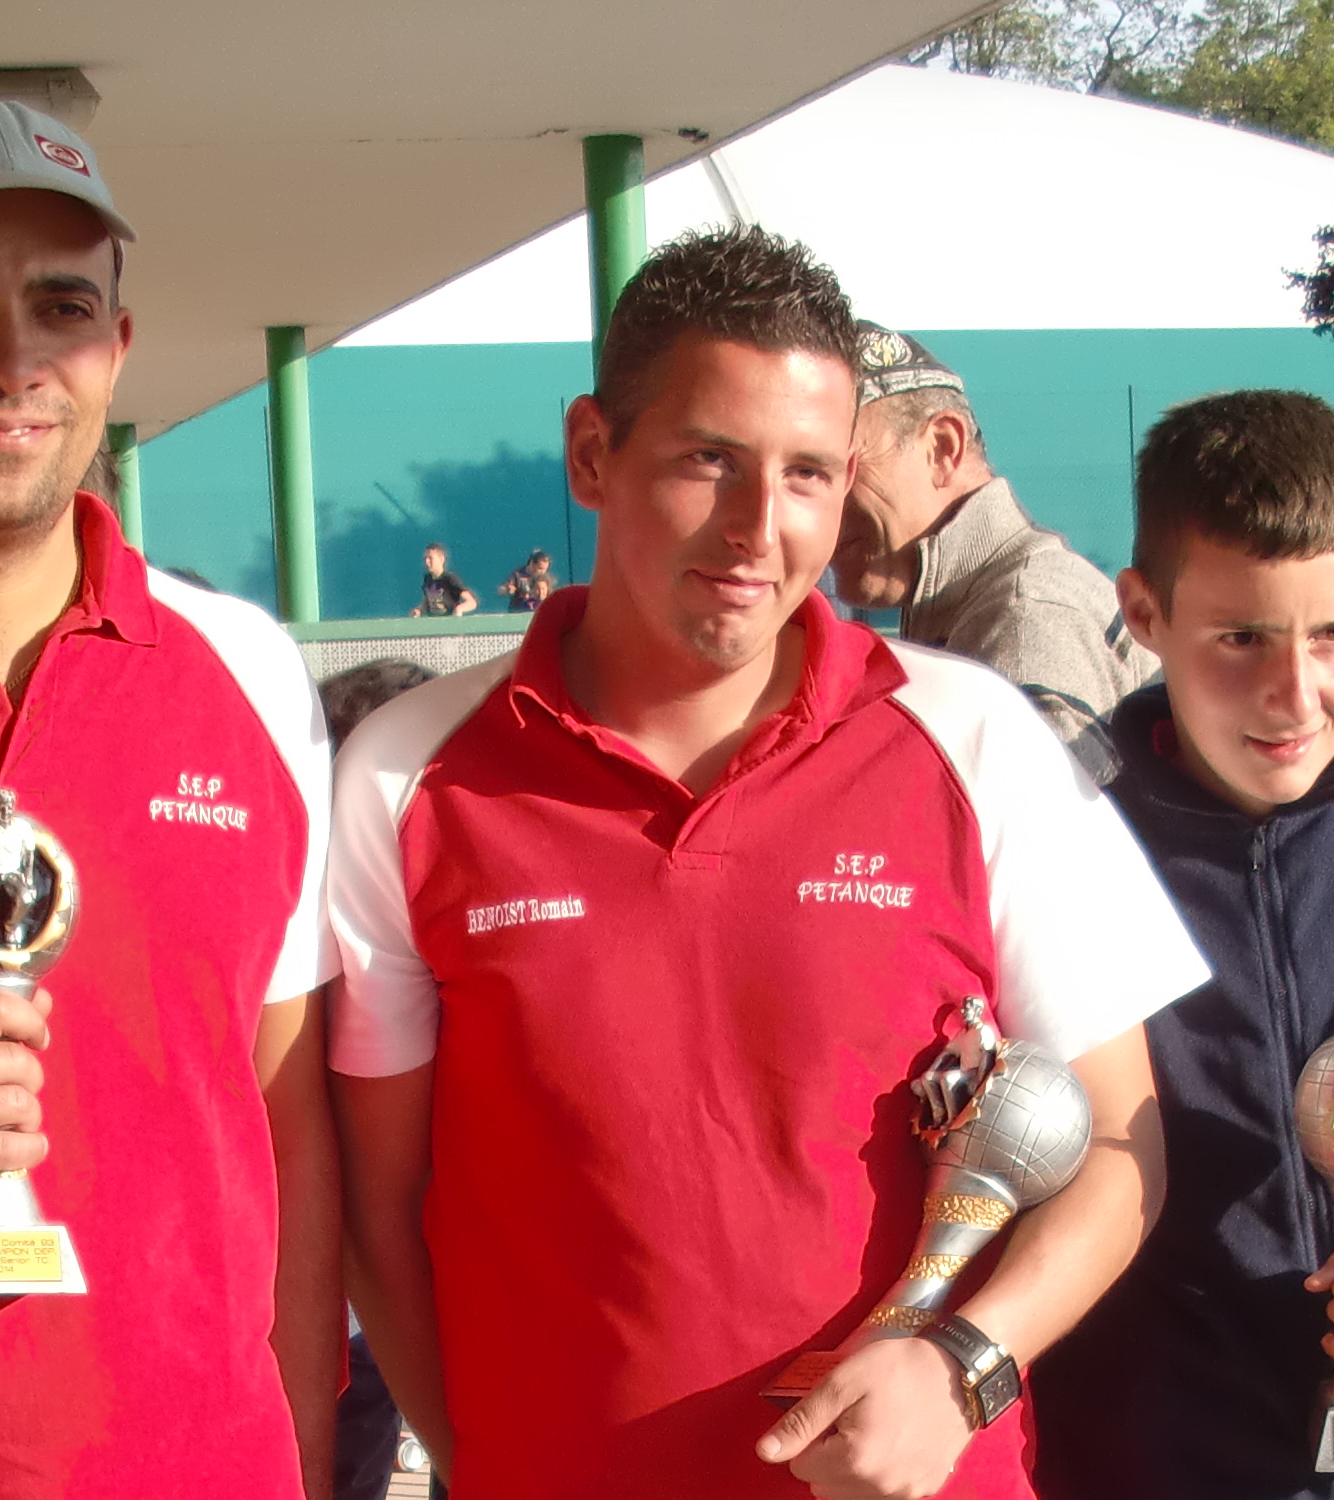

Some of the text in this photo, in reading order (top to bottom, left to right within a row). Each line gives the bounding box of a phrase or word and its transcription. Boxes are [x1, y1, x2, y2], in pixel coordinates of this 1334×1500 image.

[177, 773, 221, 799] S.E.P
[149, 799, 248, 830] PETANQUE
[833, 853, 885, 877] S.E.P
[797, 881, 914, 909] PETANQUE
[467, 894, 585, 934] BENOIST Romain
